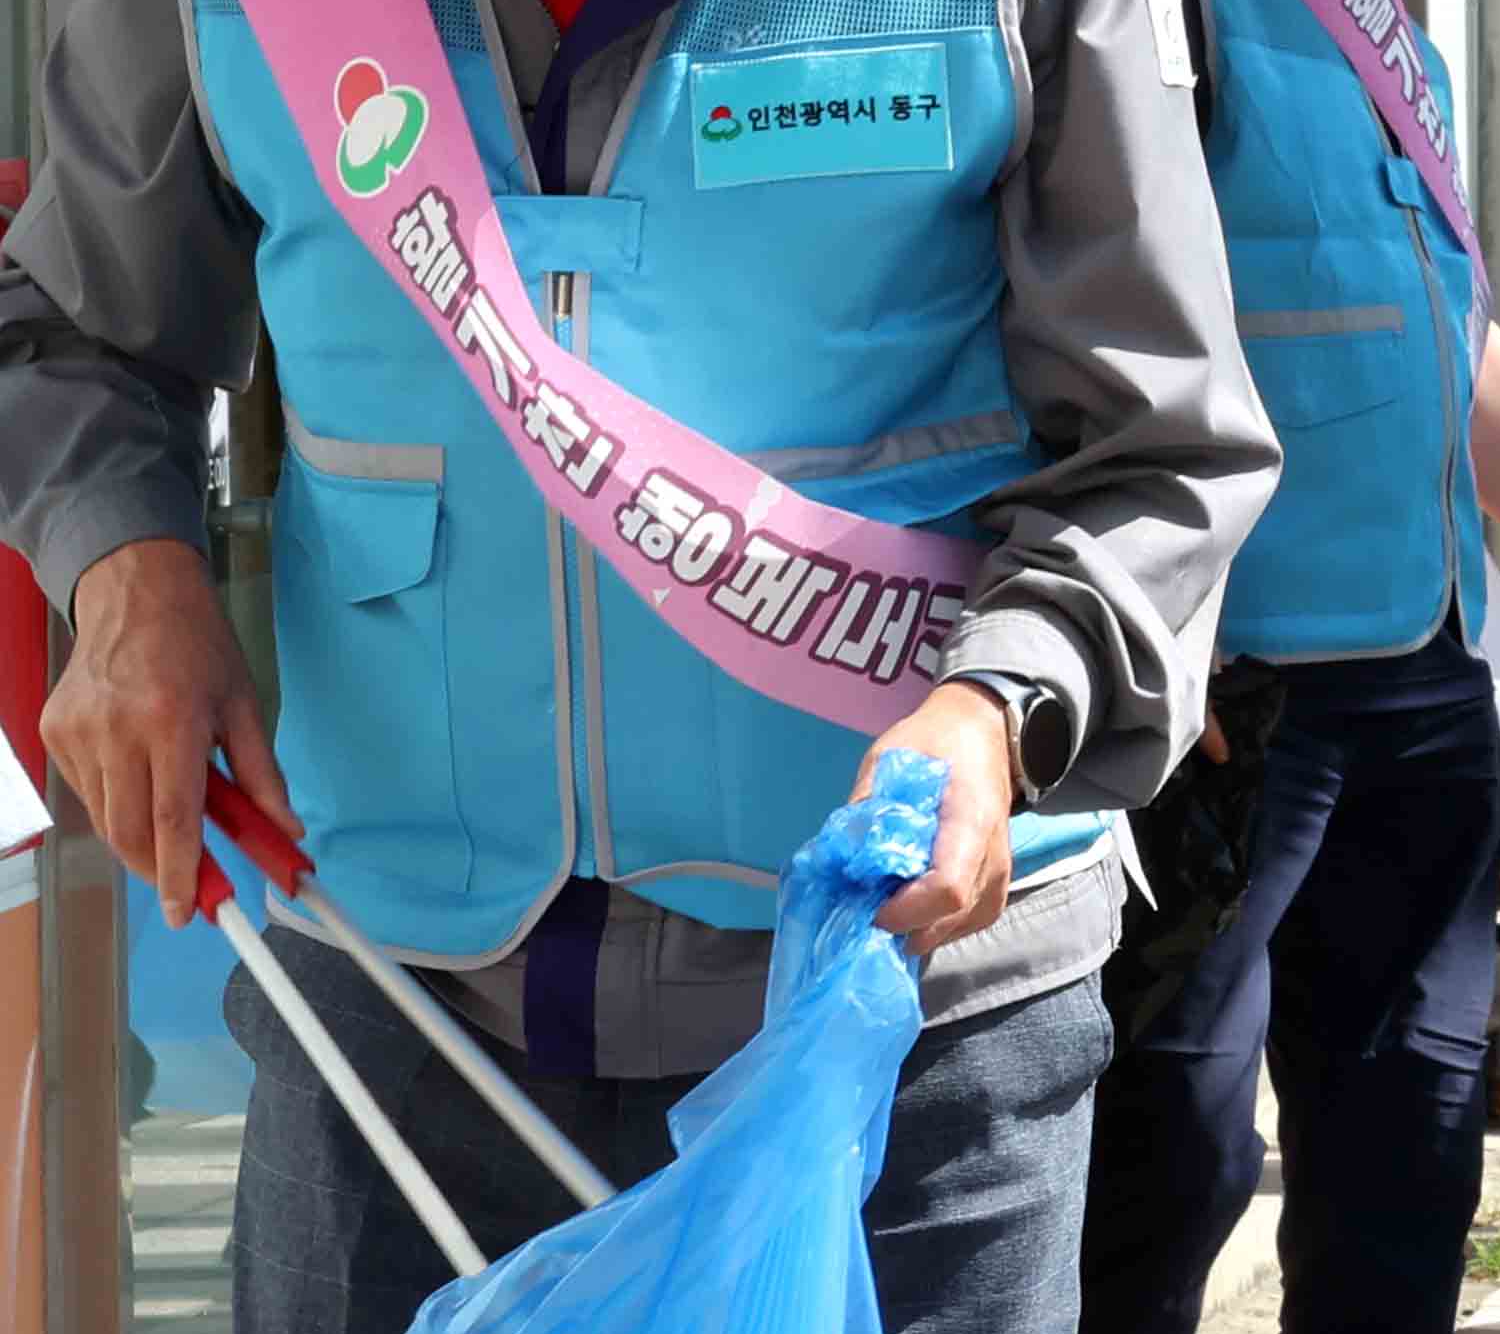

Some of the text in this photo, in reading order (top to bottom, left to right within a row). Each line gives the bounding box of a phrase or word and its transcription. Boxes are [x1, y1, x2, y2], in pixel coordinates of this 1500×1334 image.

[747, 93, 942, 135] 인천광역시 동구
[387, 186, 626, 500] 활기찬
